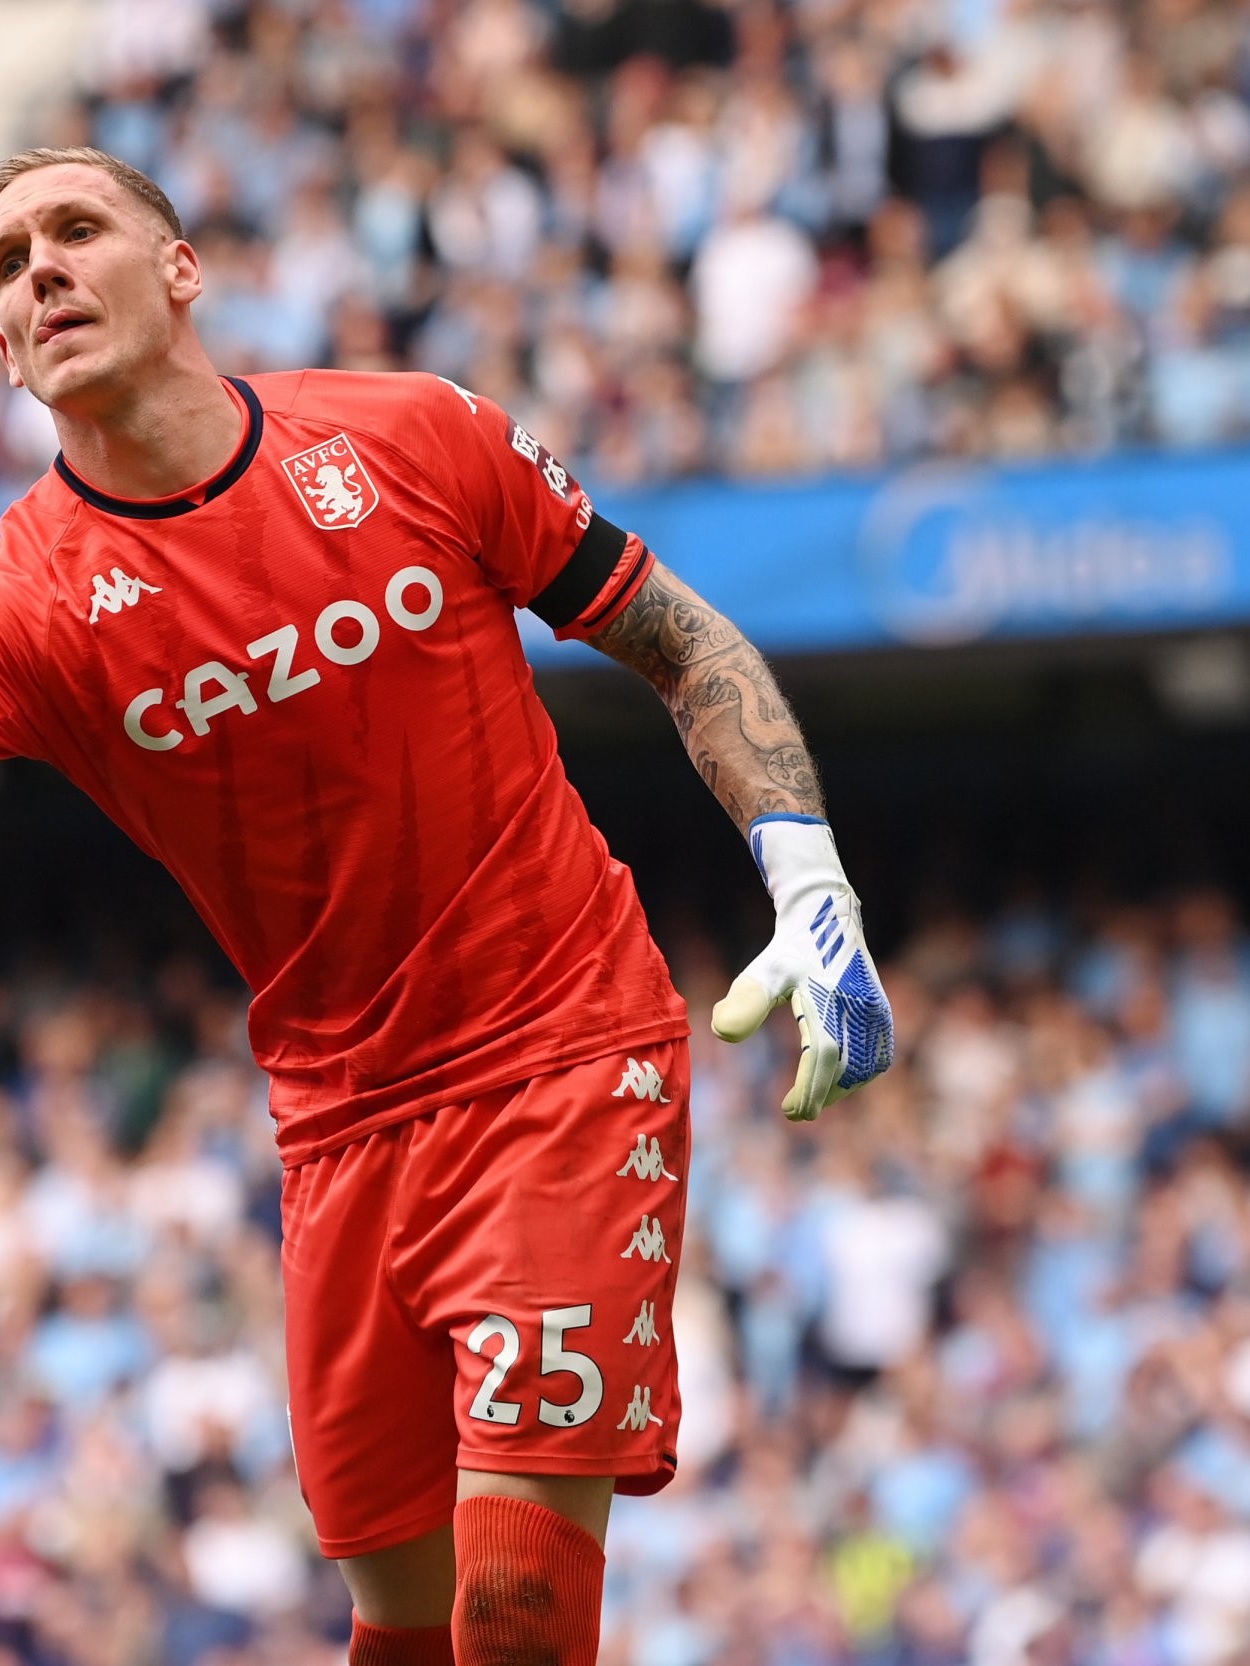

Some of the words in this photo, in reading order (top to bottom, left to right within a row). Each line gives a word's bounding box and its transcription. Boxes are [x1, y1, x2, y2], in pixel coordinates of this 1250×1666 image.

[293, 440, 347, 477] AVFC
[124, 565, 444, 752] CAZOO
[466, 1303, 604, 1428] 25
